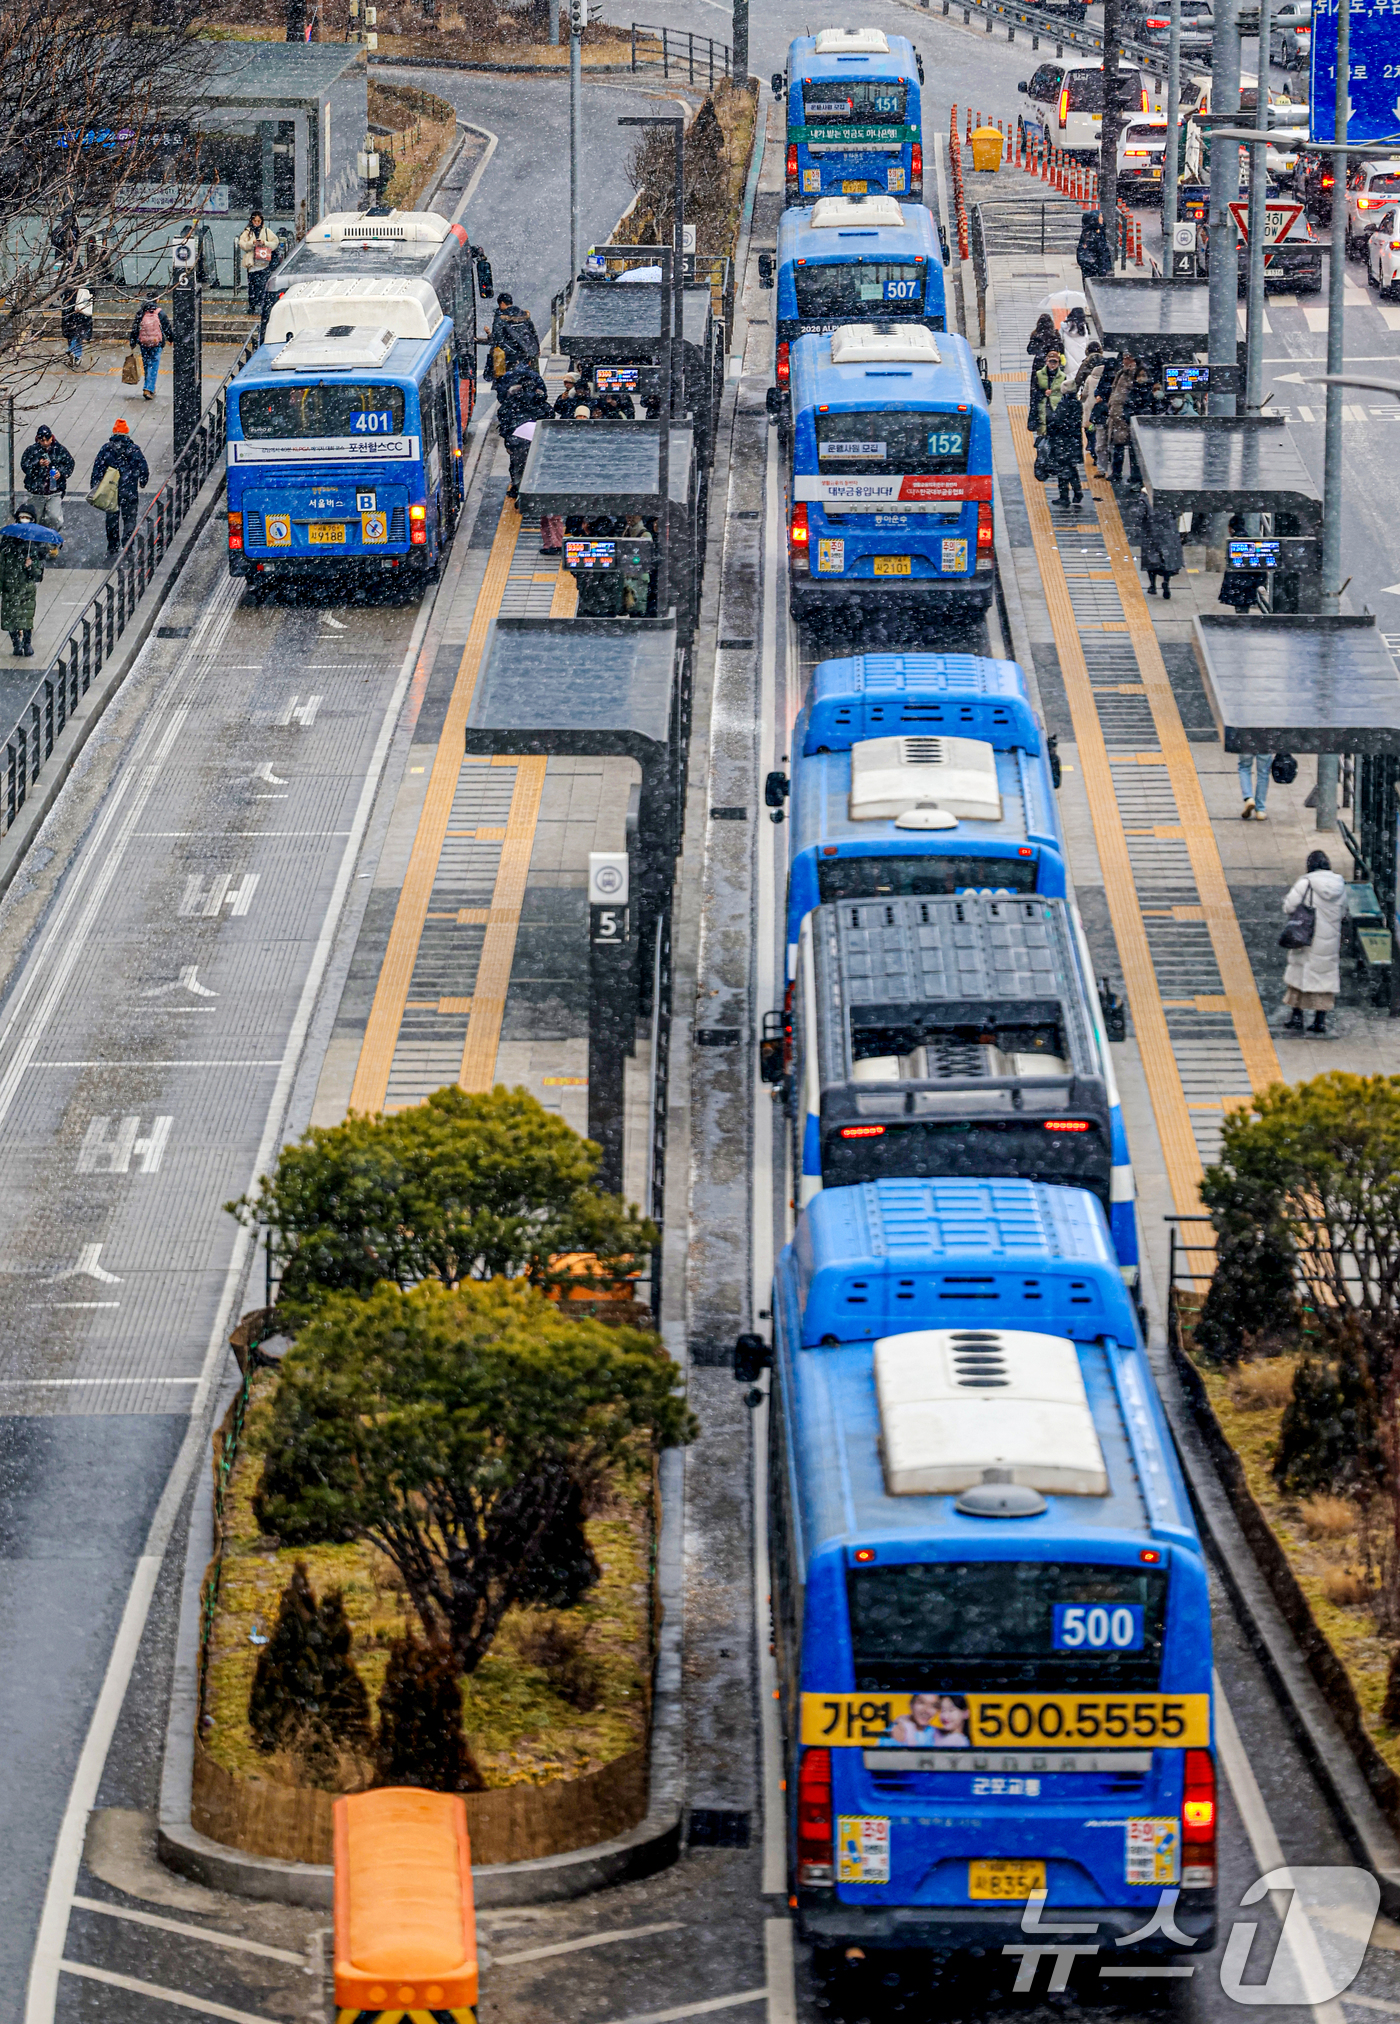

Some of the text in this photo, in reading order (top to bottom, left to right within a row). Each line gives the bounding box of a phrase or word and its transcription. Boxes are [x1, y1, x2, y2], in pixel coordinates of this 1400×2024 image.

[1328, 65, 1368, 81] 1로
[876, 97, 898, 112] 151
[810, 129, 825, 139] 내가
[1179, 256, 1190, 270] 4
[178, 272, 189, 286] 6
[887, 281, 917, 299] 507
[800, 325, 821, 333] 2026
[355, 412, 390, 432] 401
[928, 434, 963, 454] 152
[828, 486, 893, 497] 대부금융입니다!
[308, 498, 345, 509] 서울버스
[361, 496, 374, 509] B
[599, 911, 617, 937] 5
[1062, 1607, 1135, 1647] 500
[822, 1701, 1186, 1739] 가연 500.5555
